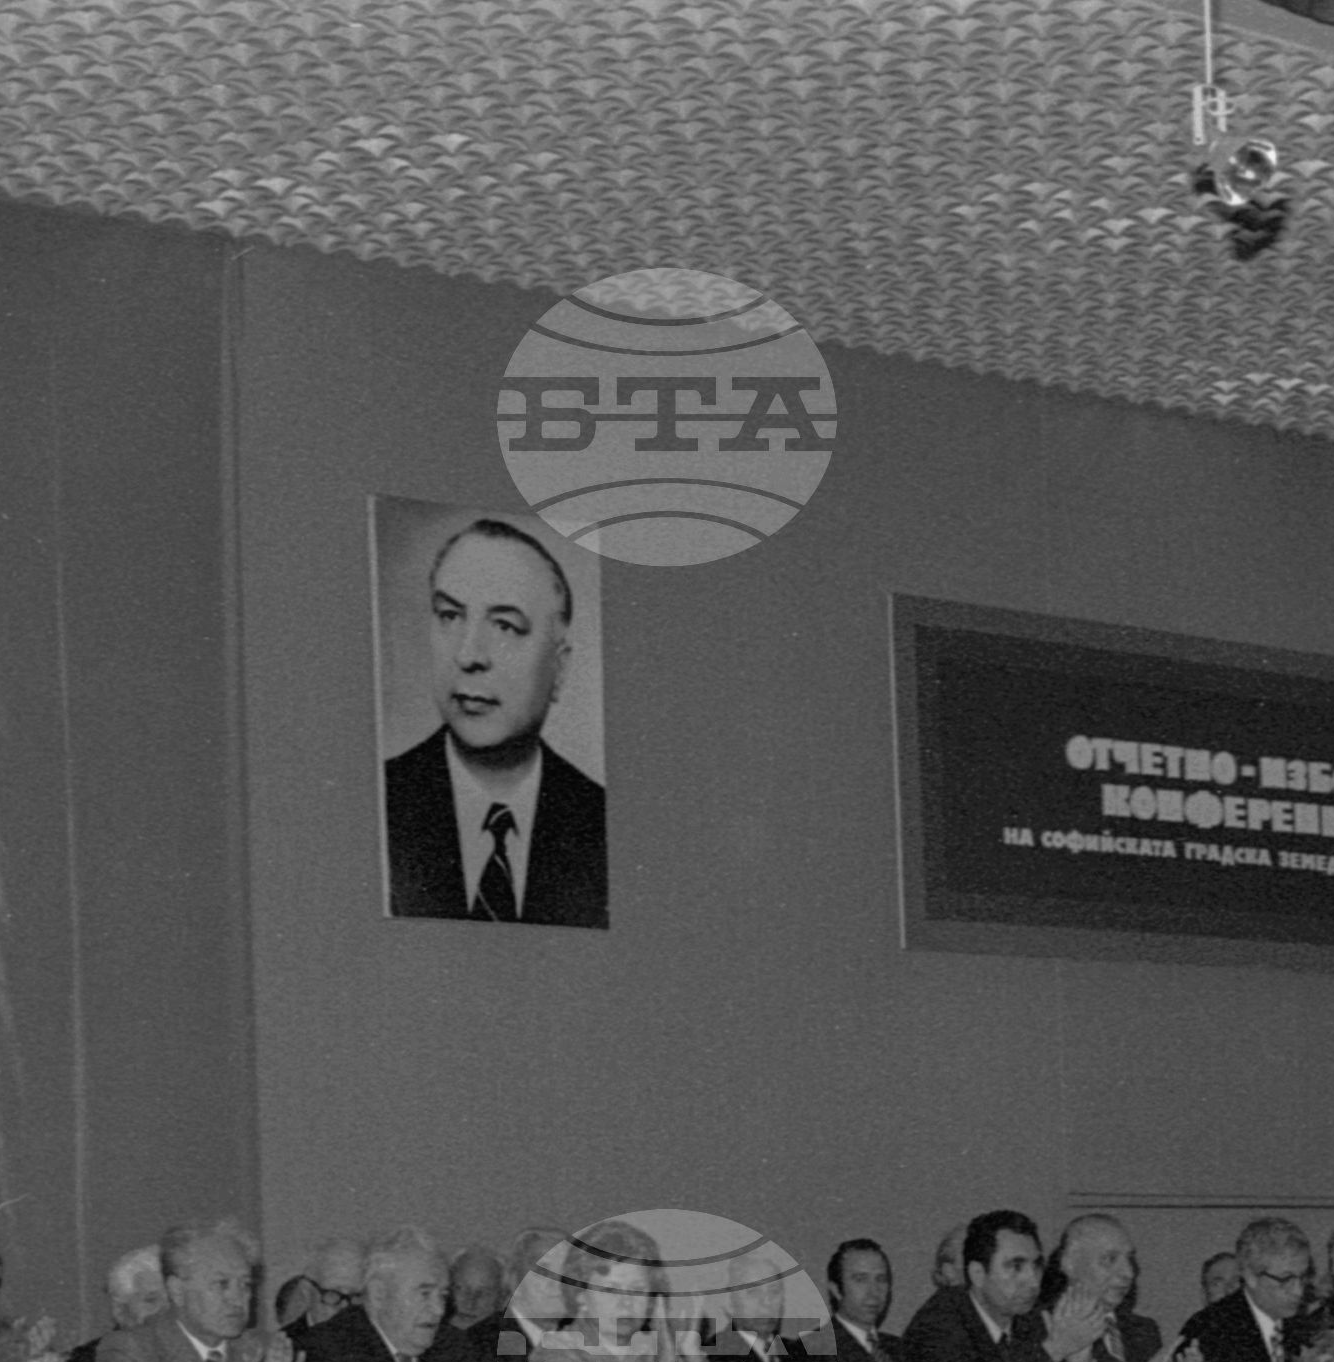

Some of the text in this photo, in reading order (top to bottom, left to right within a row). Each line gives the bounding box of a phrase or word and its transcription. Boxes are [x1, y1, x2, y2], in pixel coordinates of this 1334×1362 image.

[1002, 826, 1035, 847] НА
[1040, 829, 1178, 859] СОФИЙСКАТА
[1184, 841, 1273, 867] ГРАДСКА
